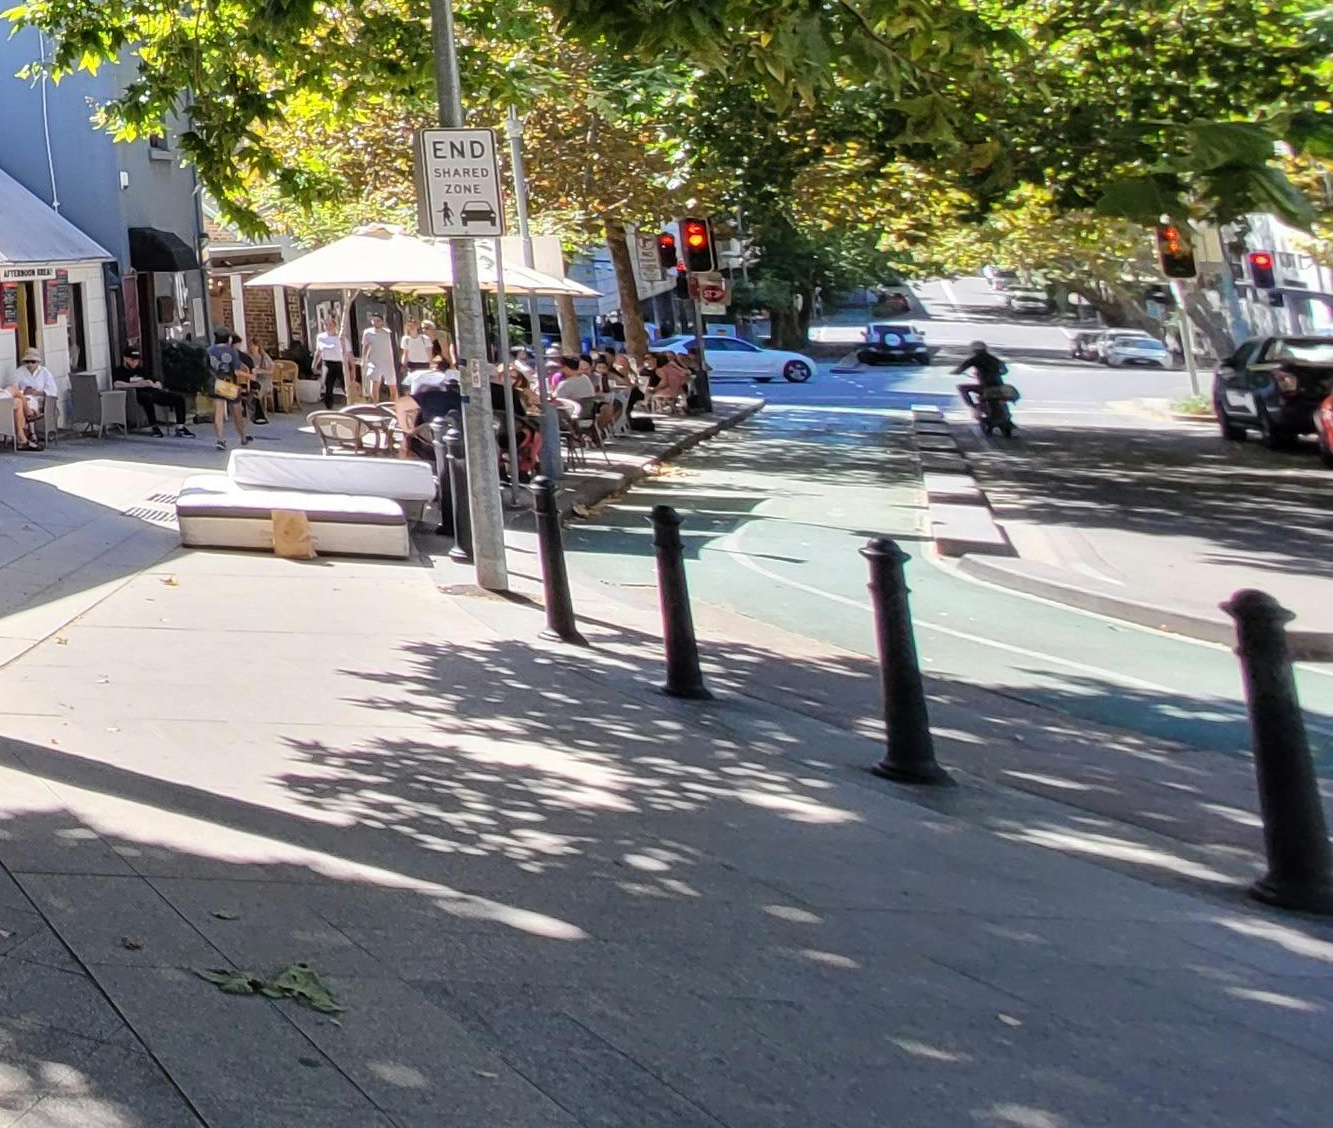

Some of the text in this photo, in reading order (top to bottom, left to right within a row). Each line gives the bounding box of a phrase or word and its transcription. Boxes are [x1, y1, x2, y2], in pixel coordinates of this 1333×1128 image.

[433, 141, 485, 159] END
[434, 168, 489, 178] SHARED
[445, 184, 481, 194] ZONE
